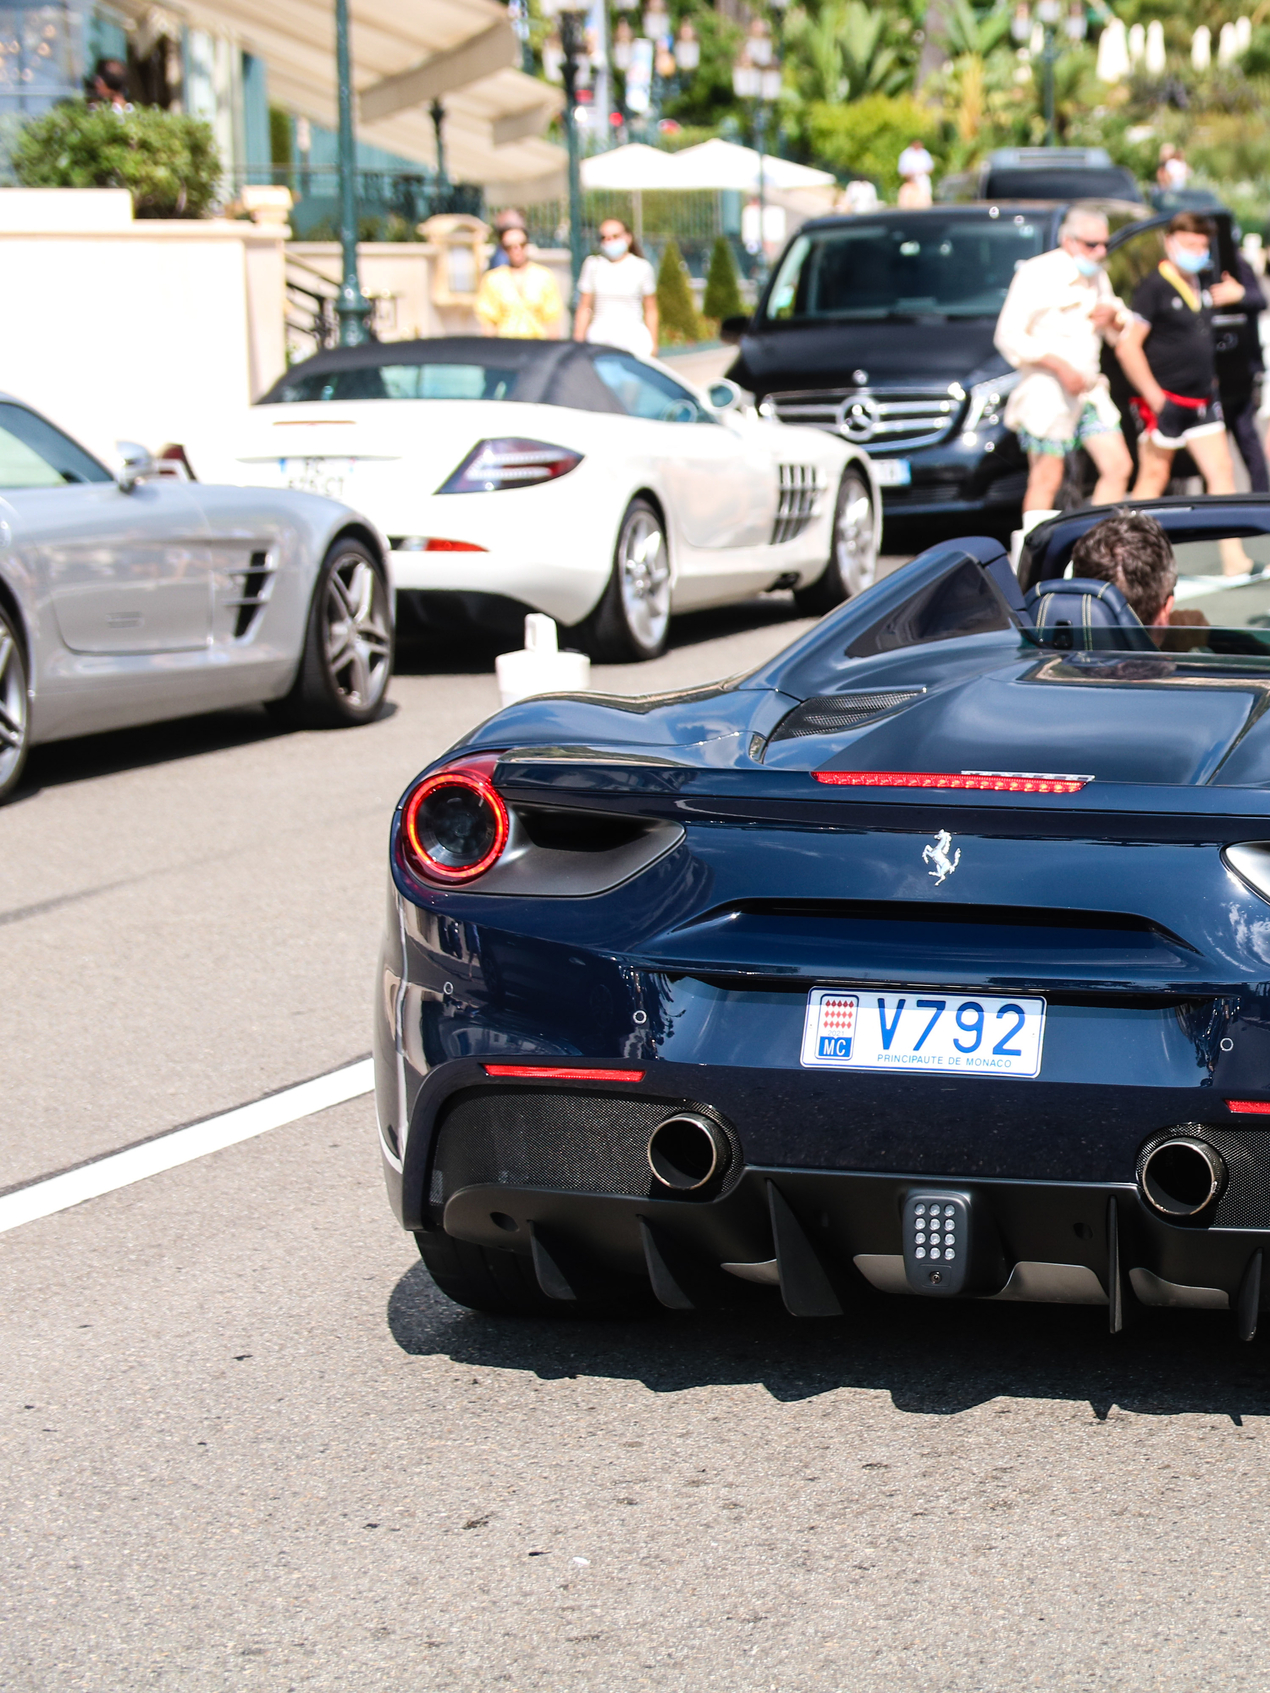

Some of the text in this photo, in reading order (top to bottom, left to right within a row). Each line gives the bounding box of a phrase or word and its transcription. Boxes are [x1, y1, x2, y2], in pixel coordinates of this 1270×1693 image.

[827, 1029, 845, 1037] 2021
[877, 998, 1025, 1056] V792
[823, 1039, 846, 1056] MC
[877, 1053, 1012, 1068] PRINCIPAUTE DE MONACO
